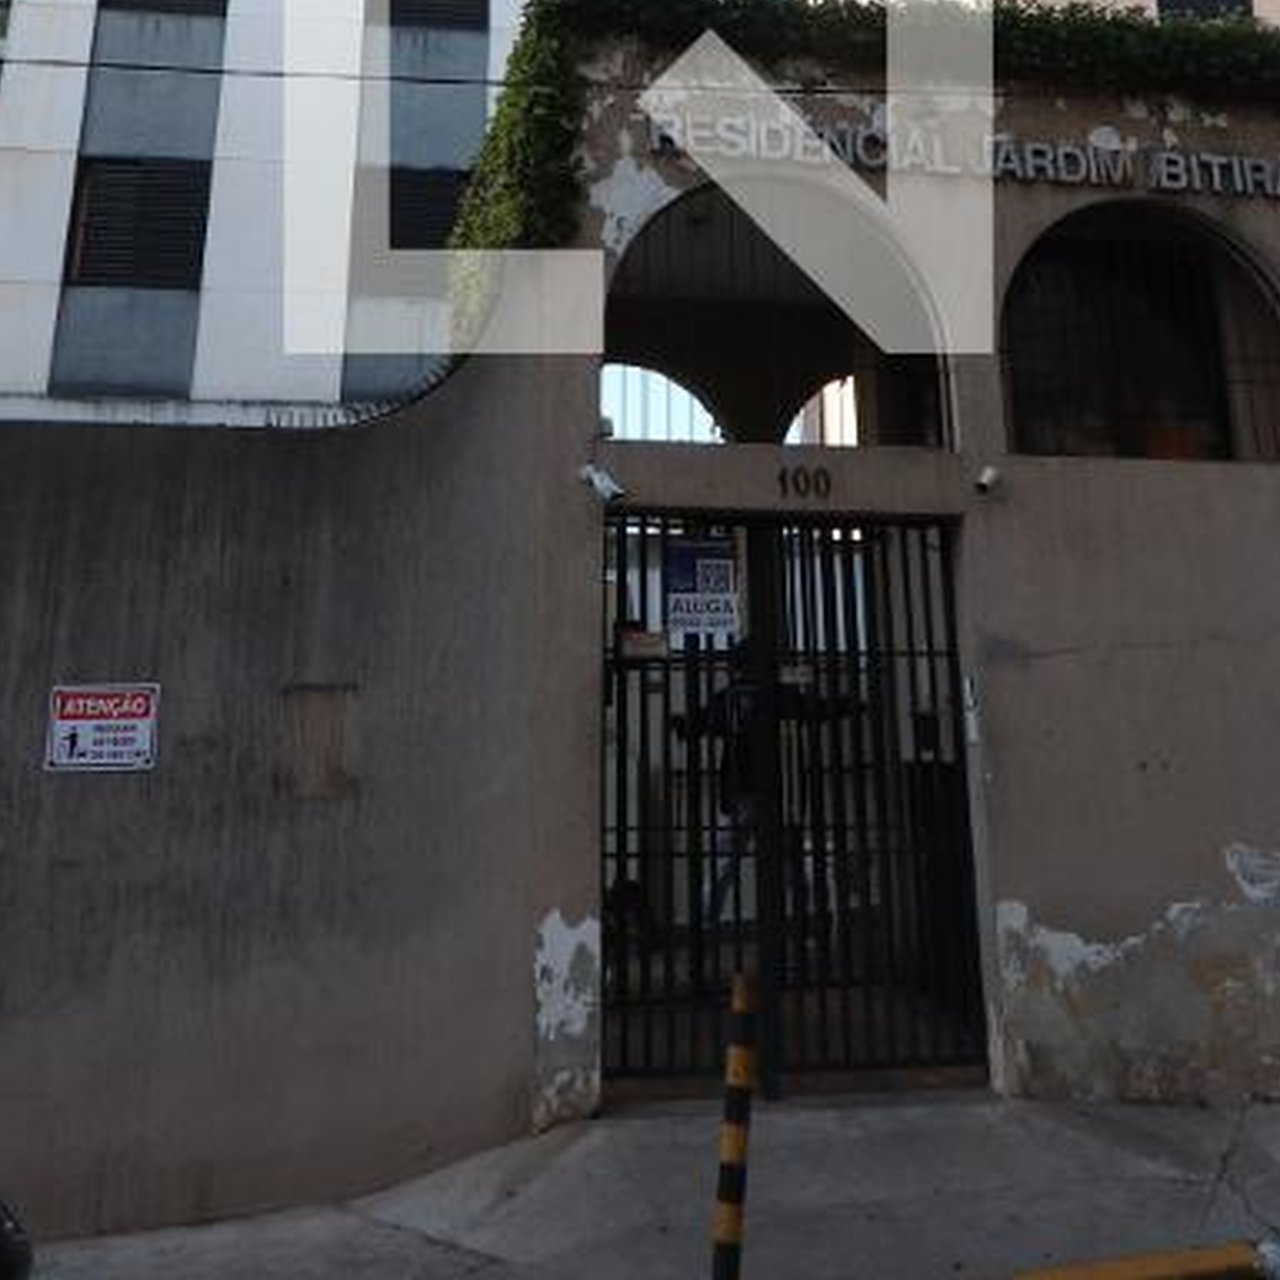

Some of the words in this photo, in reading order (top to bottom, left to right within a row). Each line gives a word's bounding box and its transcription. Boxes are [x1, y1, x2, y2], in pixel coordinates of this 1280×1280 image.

[650, 113, 963, 175] RESIDENCIAL
[974, 132, 1135, 186] JARDIM
[777, 465, 832, 498] 100
[671, 599, 735, 615] ALUGA
[63, 694, 147, 717] ATENÇÃO
